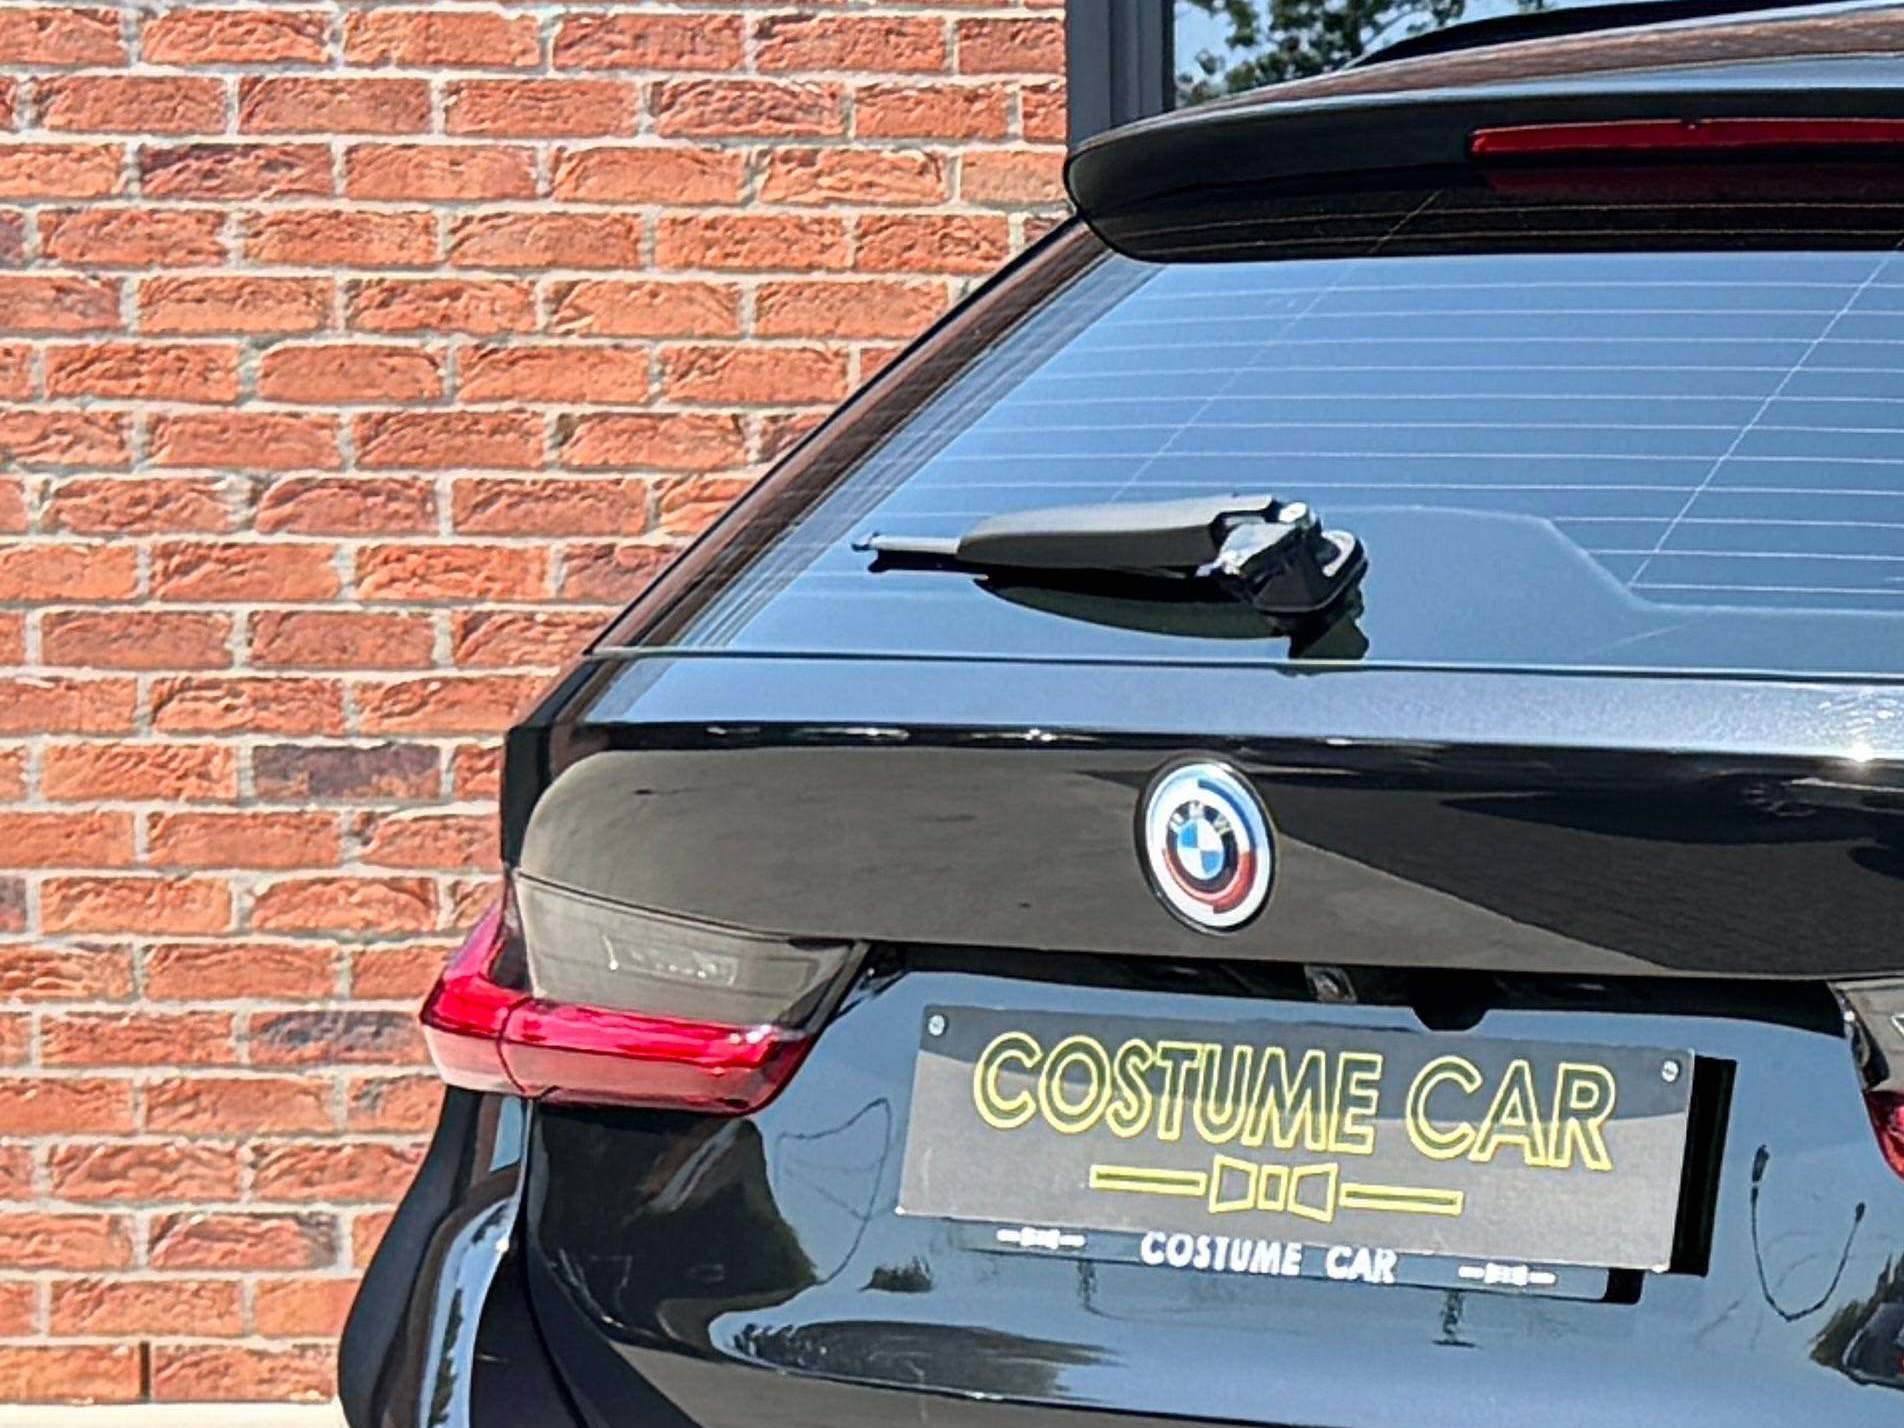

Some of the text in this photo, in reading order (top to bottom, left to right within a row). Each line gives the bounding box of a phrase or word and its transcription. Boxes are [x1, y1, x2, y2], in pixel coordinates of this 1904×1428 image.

[973, 1030, 1615, 1171] COSTUME CAR
[1140, 1231, 1398, 1284] COSTUME CAR
